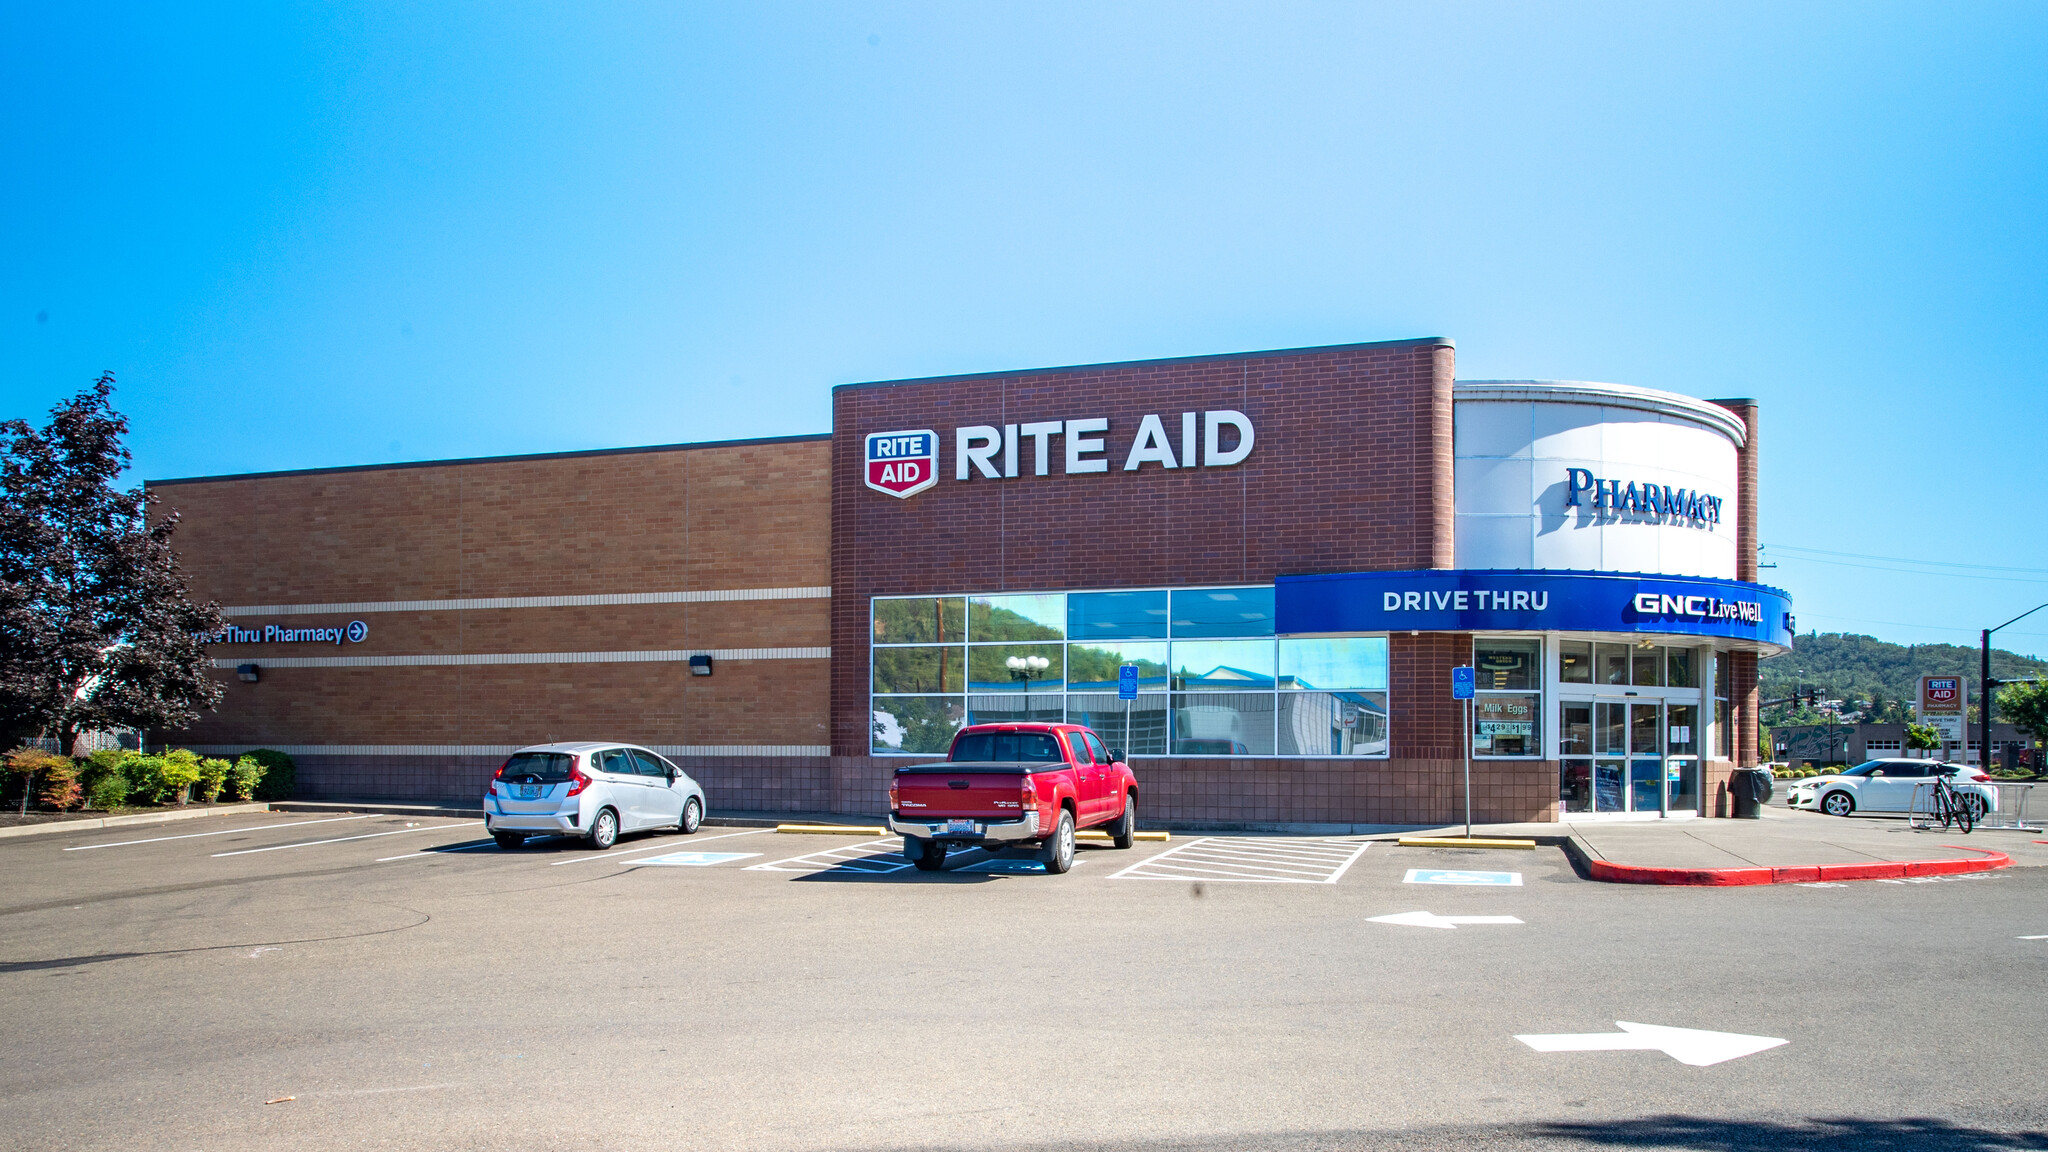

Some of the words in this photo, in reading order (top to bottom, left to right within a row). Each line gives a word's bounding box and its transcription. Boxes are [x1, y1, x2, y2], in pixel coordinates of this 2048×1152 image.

[877, 436, 923, 457] RITE
[956, 417, 1109, 480] RITE
[1123, 409, 1255, 470] AID
[880, 463, 920, 484] AID
[1383, 590, 1469, 612] DRIVE
[1473, 590, 1549, 611] THRU
[1635, 593, 1706, 616] GNC
[226, 625, 260, 643] Thru
[265, 625, 344, 646] Pharmacy
[1933, 690, 1951, 698] AID
[1484, 703, 1503, 713] Milk
[1507, 703, 1528, 715] Eggs
